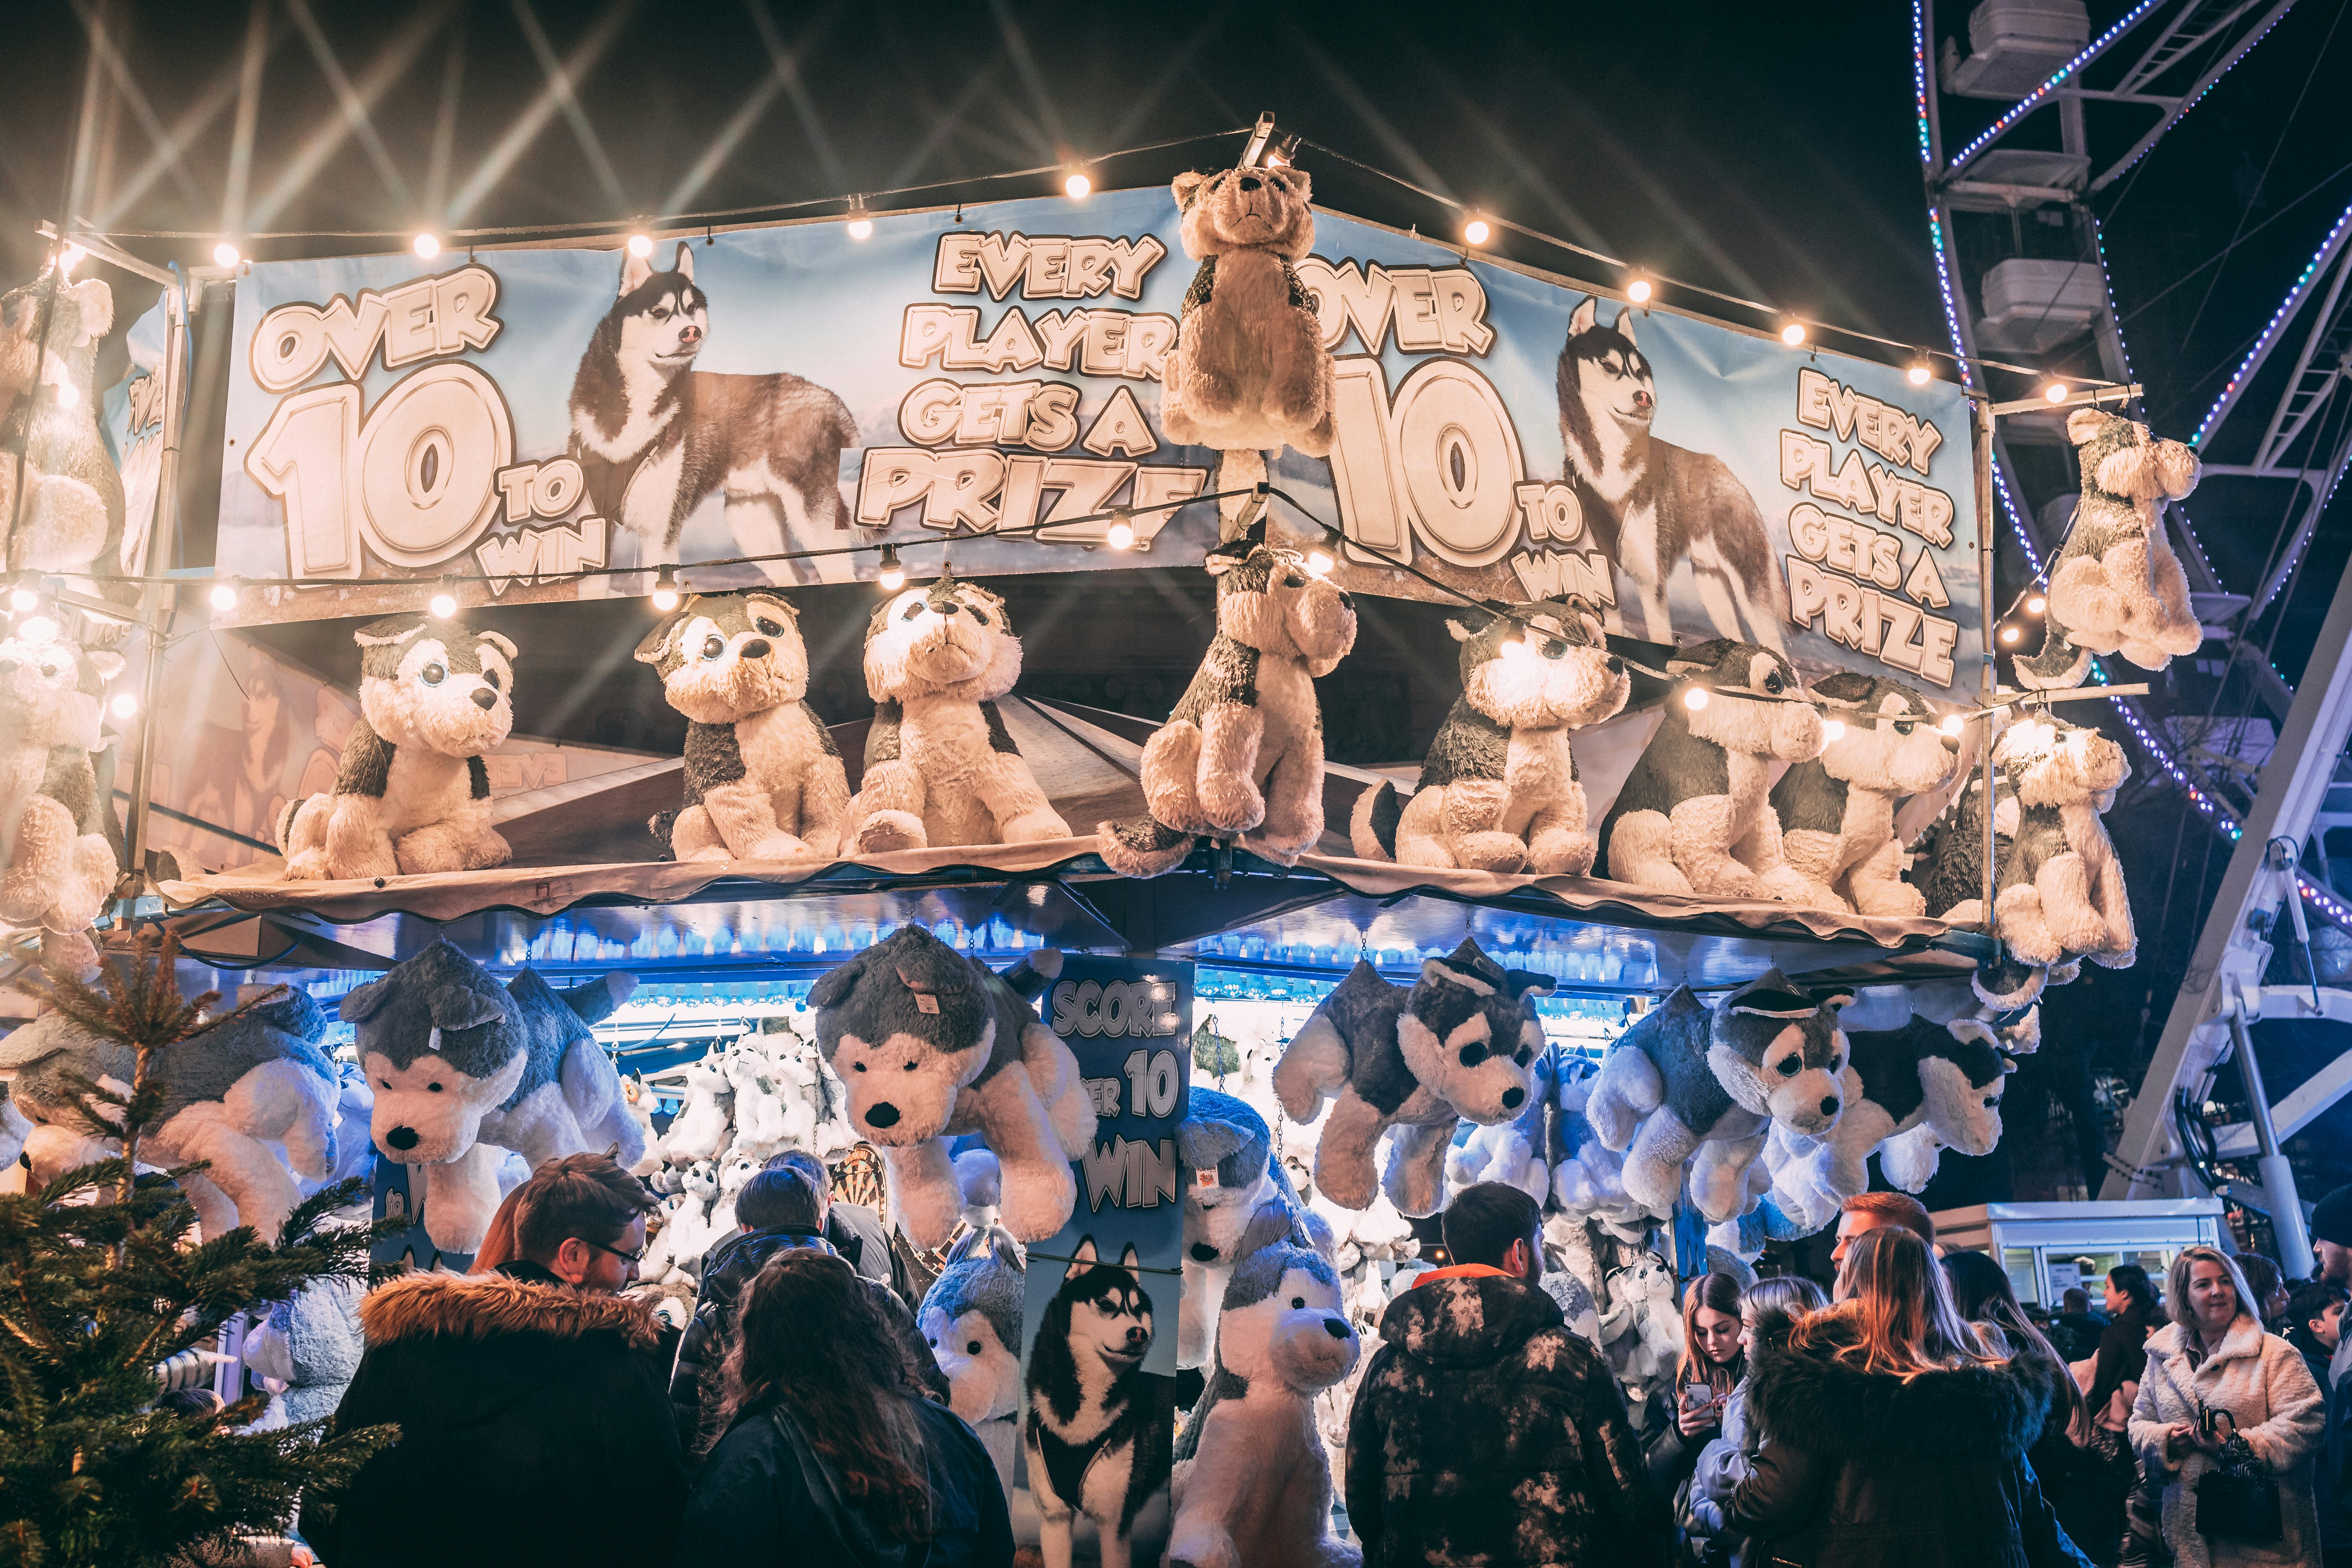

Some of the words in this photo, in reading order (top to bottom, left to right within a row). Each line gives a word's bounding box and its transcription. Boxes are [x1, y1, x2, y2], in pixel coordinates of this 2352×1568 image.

[936, 234, 1164, 299] EVERY
[254, 268, 500, 389] OVER
[904, 306, 1177, 379] PLAYER
[1292, 258, 1493, 356] OVER
[901, 381, 1078, 451] GETS
[1083, 389, 1156, 456] A
[1799, 369, 1942, 475] EVERY
[247, 364, 511, 588] 10
[499, 459, 583, 522] TO
[857, 451, 1206, 551] PRIZE
[1329, 361, 1524, 567] 10
[1782, 431, 1954, 548] PLAYER
[1516, 484, 1582, 541] TO
[476, 519, 605, 596] WIN
[1514, 551, 1613, 607] WIN
[1790, 505, 1901, 589] GETS
[1905, 548, 1949, 607] A
[1787, 557, 1958, 686] PRIZE
[1052, 980, 1176, 1037] SCORE
[1124, 1050, 1178, 1117] 10
[1083, 1135, 1176, 1212] WIN
